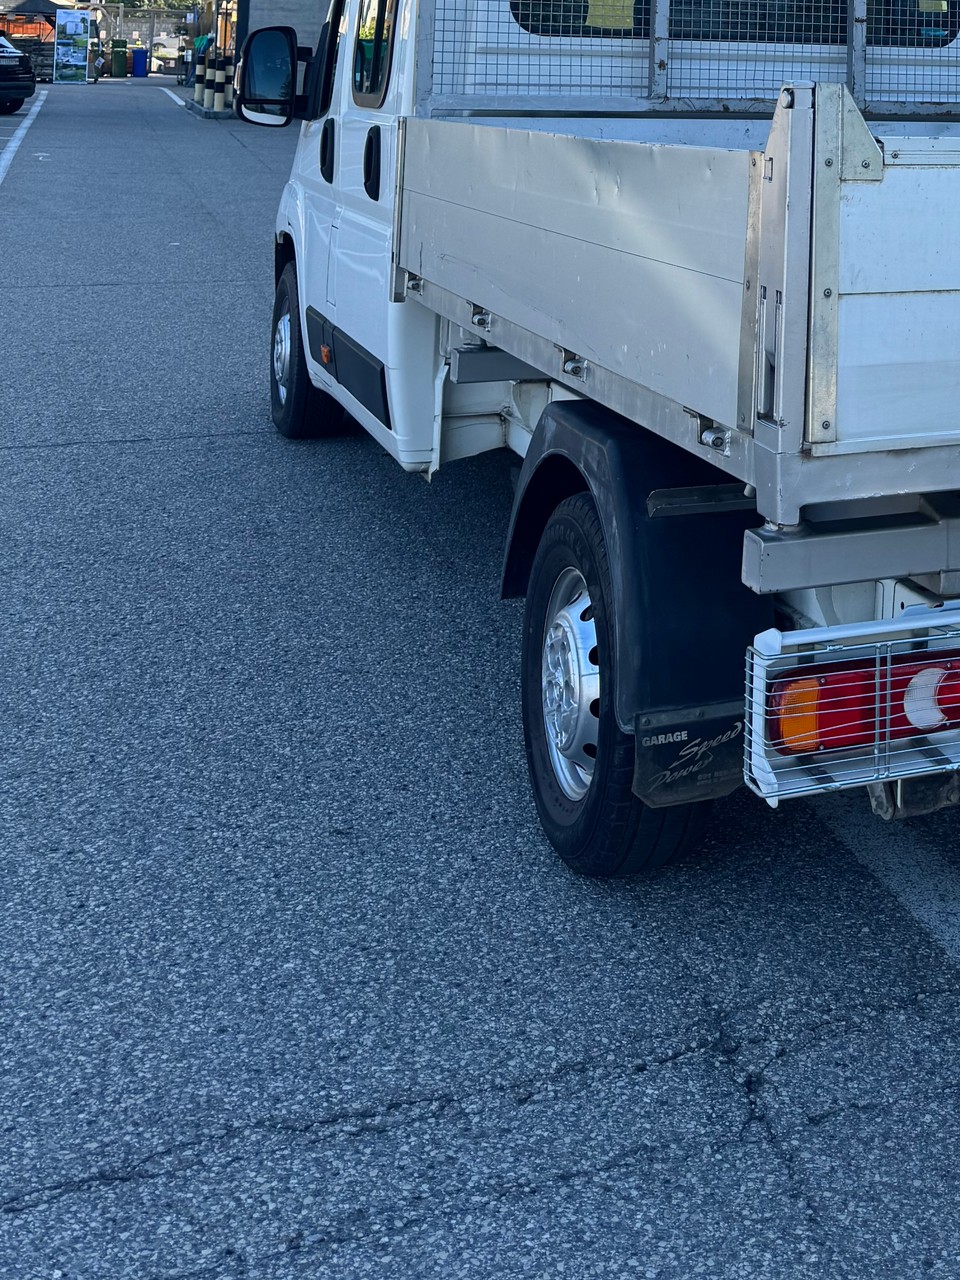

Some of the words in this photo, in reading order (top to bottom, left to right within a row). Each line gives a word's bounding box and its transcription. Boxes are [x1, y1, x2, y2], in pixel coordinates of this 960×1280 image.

[641, 730, 688, 747] GARAGE
[668, 721, 742, 769] Speed
[647, 751, 714, 793] Power
